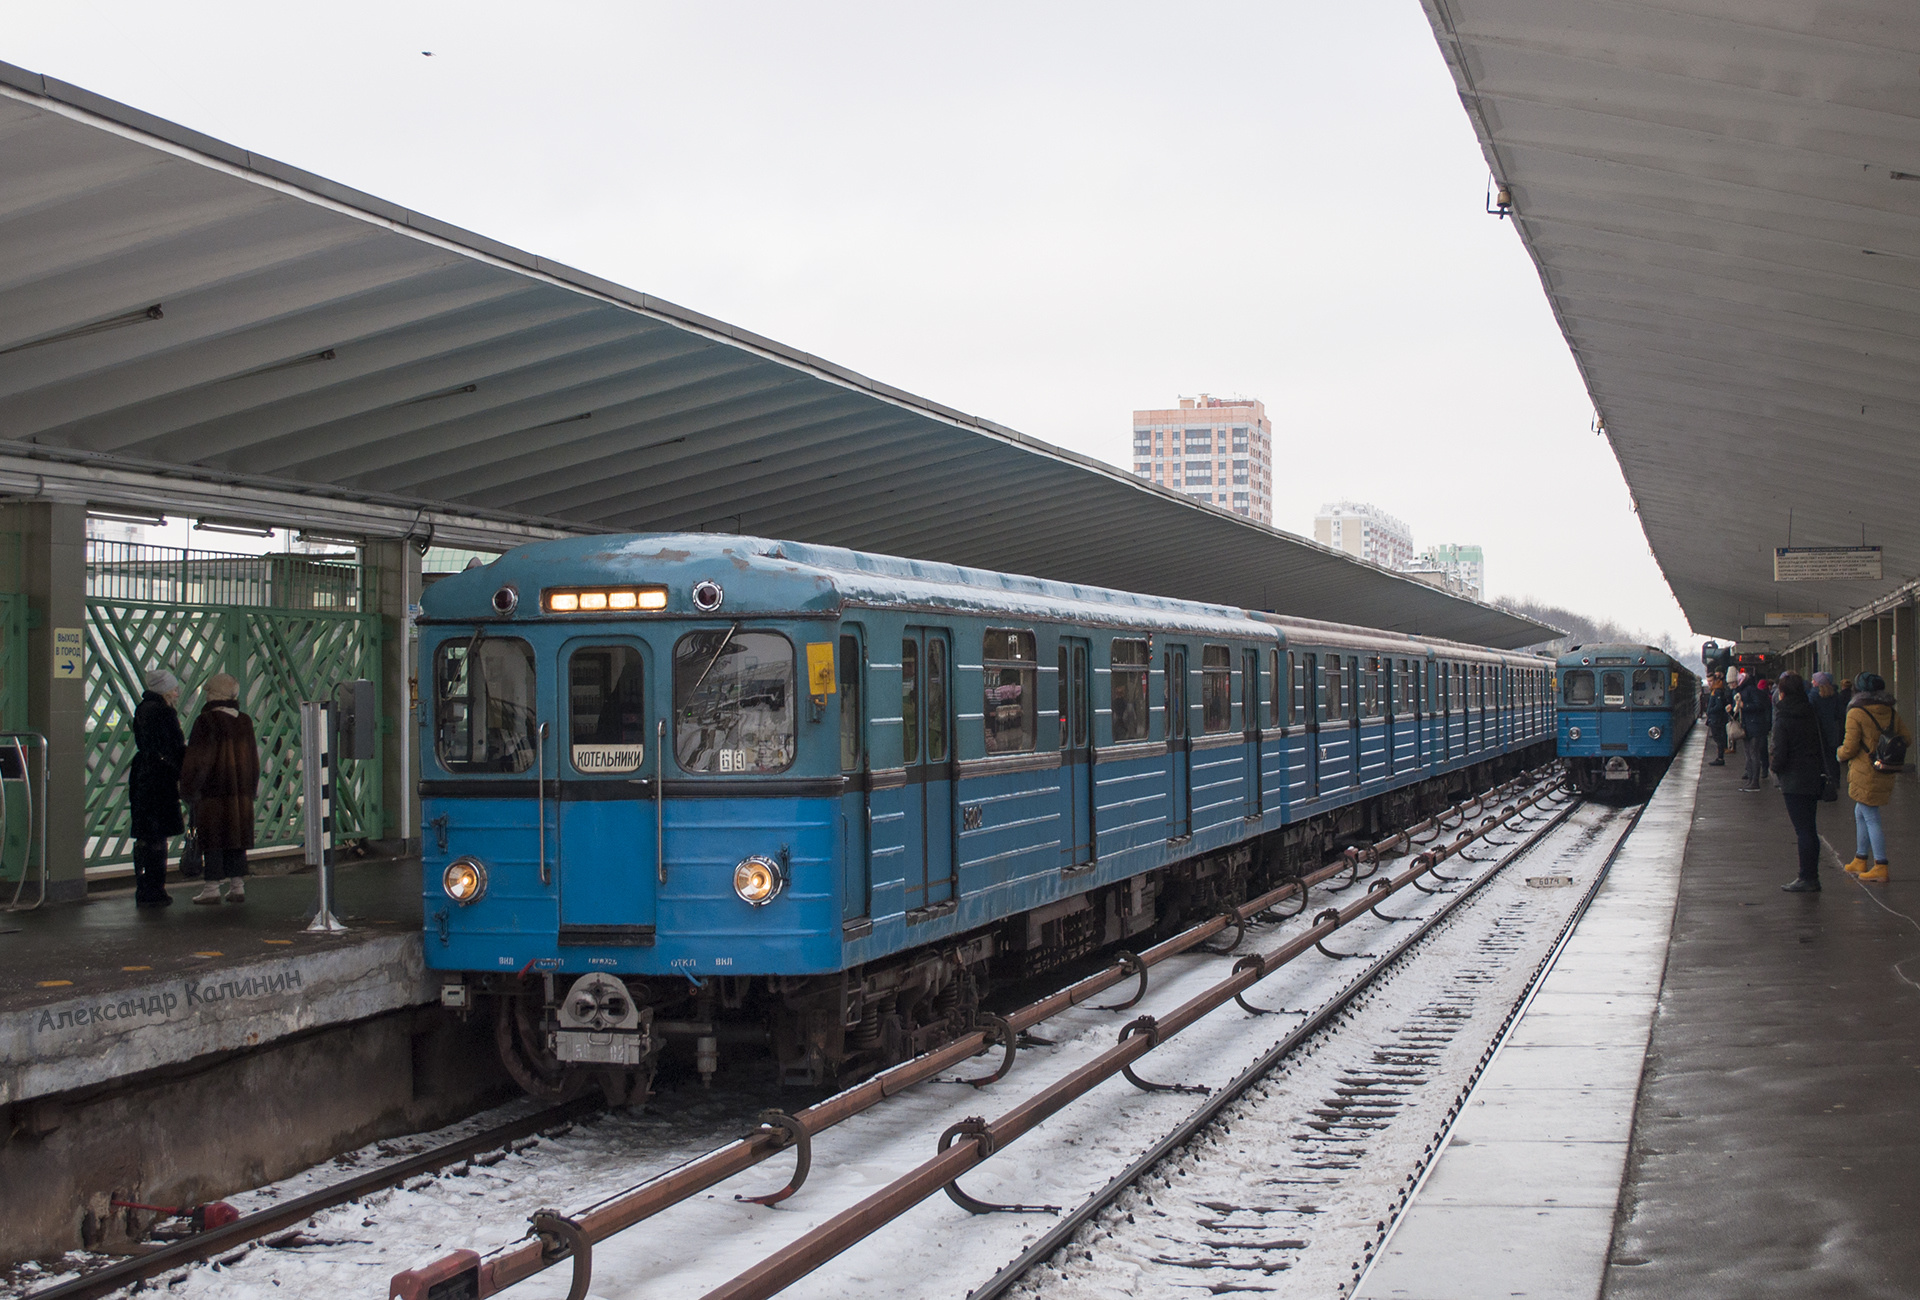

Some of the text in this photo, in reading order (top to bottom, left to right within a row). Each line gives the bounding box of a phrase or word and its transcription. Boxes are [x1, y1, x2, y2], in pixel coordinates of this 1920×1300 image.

[58, 633, 79, 644] ВЫХОД
[56, 646, 81, 658] В ГОРОД
[577, 751, 641, 767] КОТЕЛЬНИКИ
[498, 956, 514, 965] ВКЛ
[670, 958, 697, 967] ОТКЛ
[715, 957, 733, 966] ВКЛ
